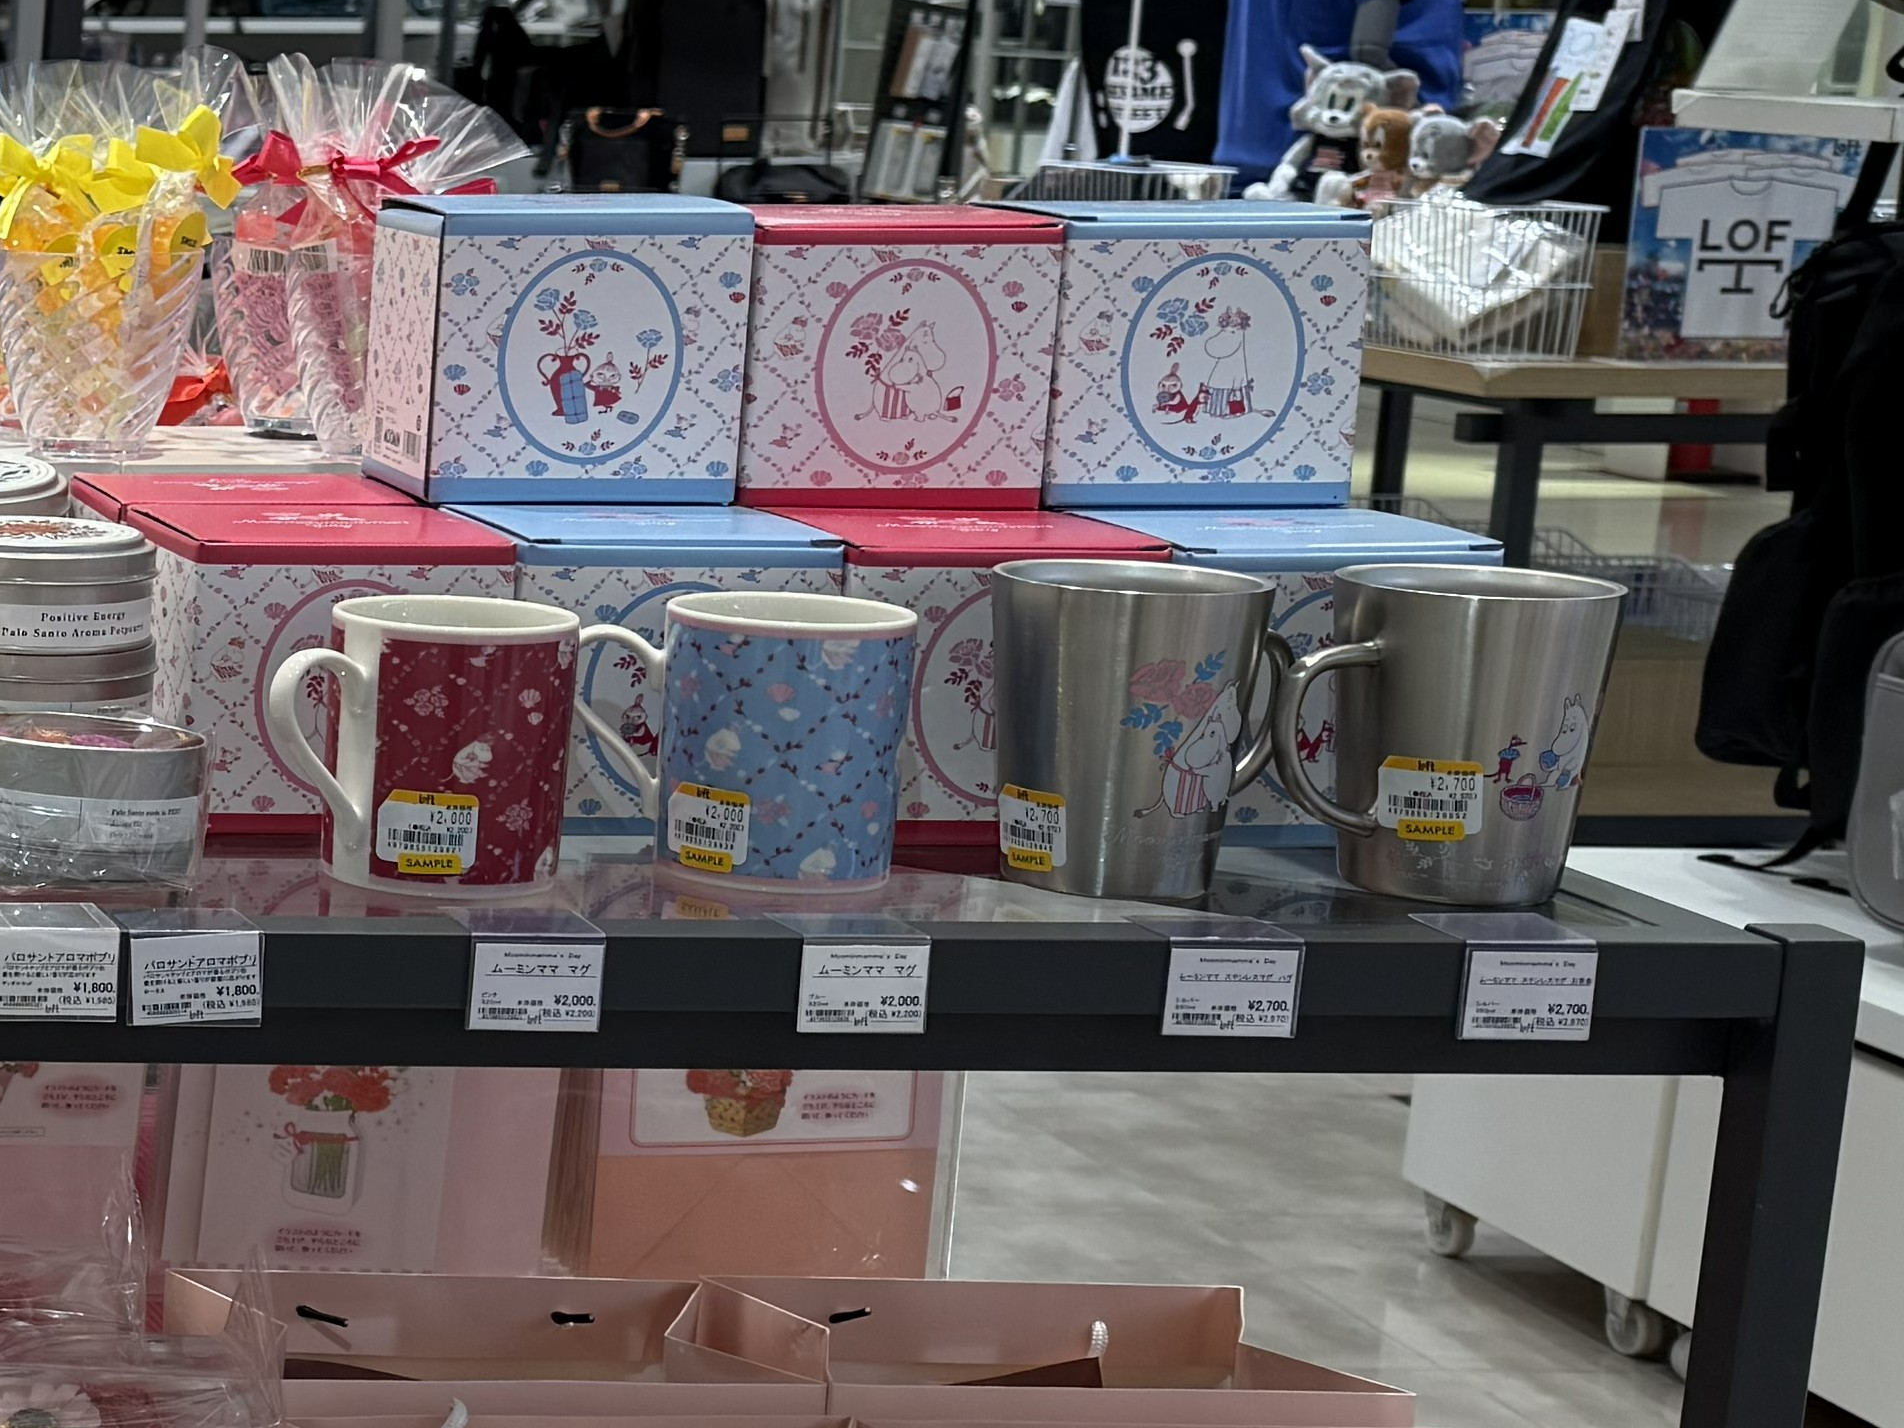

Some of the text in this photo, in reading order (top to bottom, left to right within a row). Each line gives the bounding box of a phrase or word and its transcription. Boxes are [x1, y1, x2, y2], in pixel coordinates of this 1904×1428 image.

[1699, 219, 1791, 253] LOF
[40, 611, 127, 624] Positive Energy
[1, 625, 107, 639] Palo Santo Aroma
[1404, 823, 1457, 835] SAMPLE
[405, 857, 454, 869] SAMPLE
[684, 849, 725, 867] SAMPLE
[1011, 851, 1045, 867] SAMPLE
[491, 962, 593, 975] ムーミンママ マグ
[819, 963, 915, 977] ムーミンママ マグ
